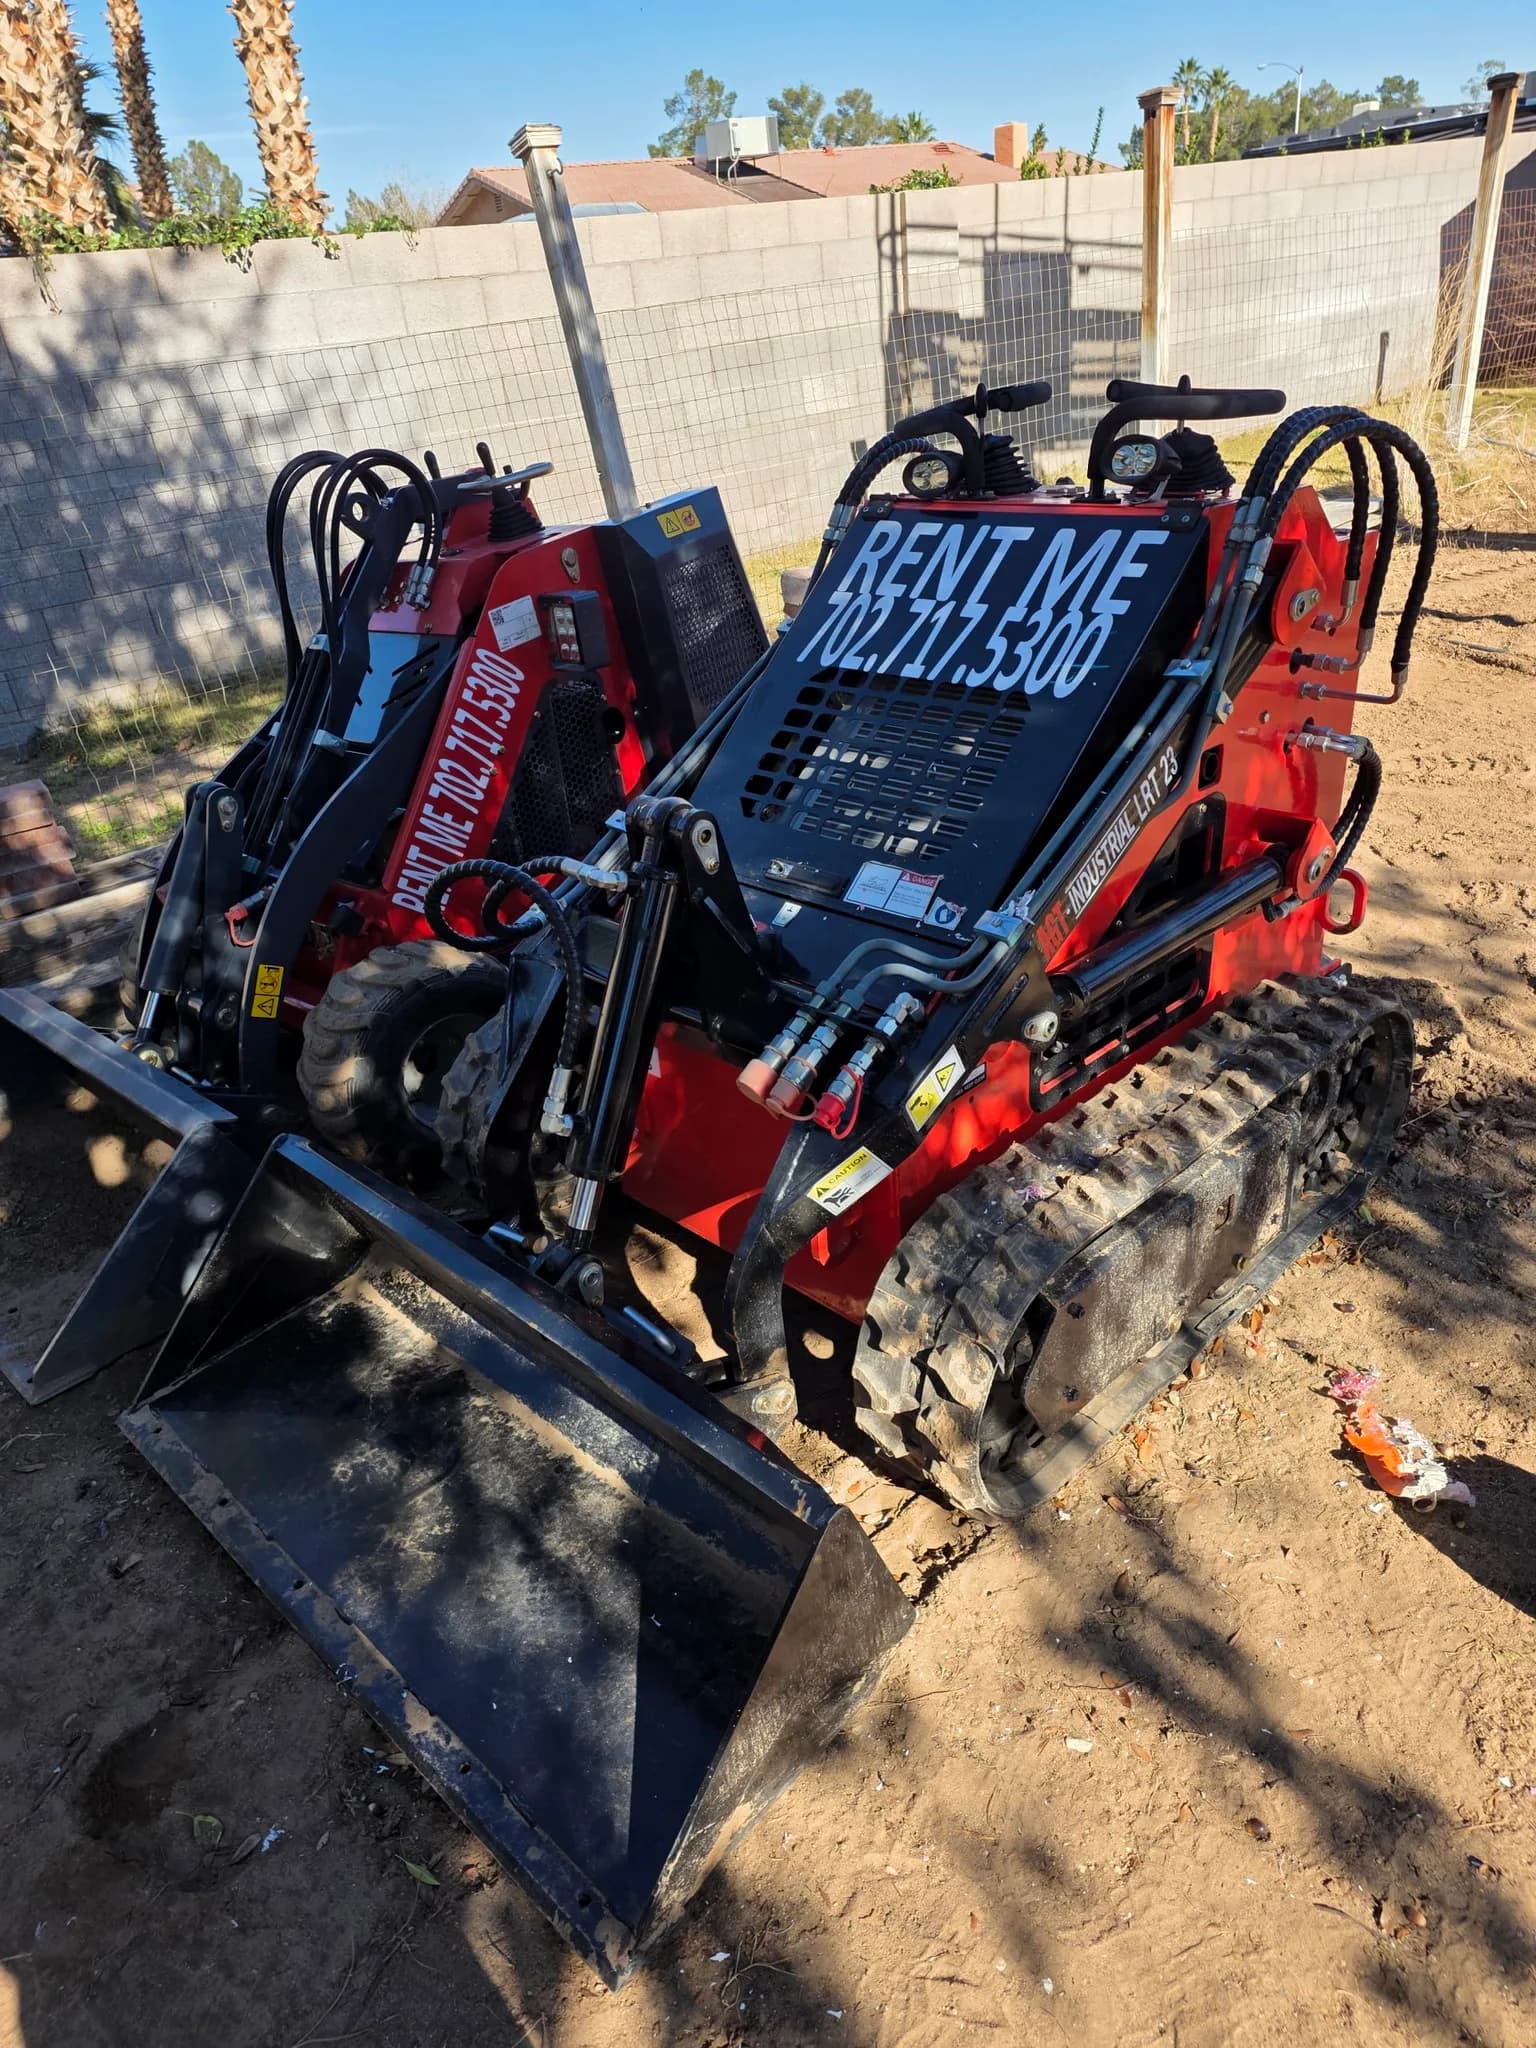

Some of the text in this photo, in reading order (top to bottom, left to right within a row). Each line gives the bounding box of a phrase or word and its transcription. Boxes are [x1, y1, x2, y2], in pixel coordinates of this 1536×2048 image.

[837, 520, 1170, 615] RENT ME
[797, 591, 1114, 699] 702.717.5300
[428, 648, 525, 816] 702.717.5300
[414, 802, 474, 859] ME
[1067, 812, 1137, 914] INDUSTRIAL
[1133, 769, 1161, 821] LRT
[1159, 746, 1179, 787] 23
[391, 845, 453, 914] RENT
[828, 1153, 868, 1185] CAUTION
